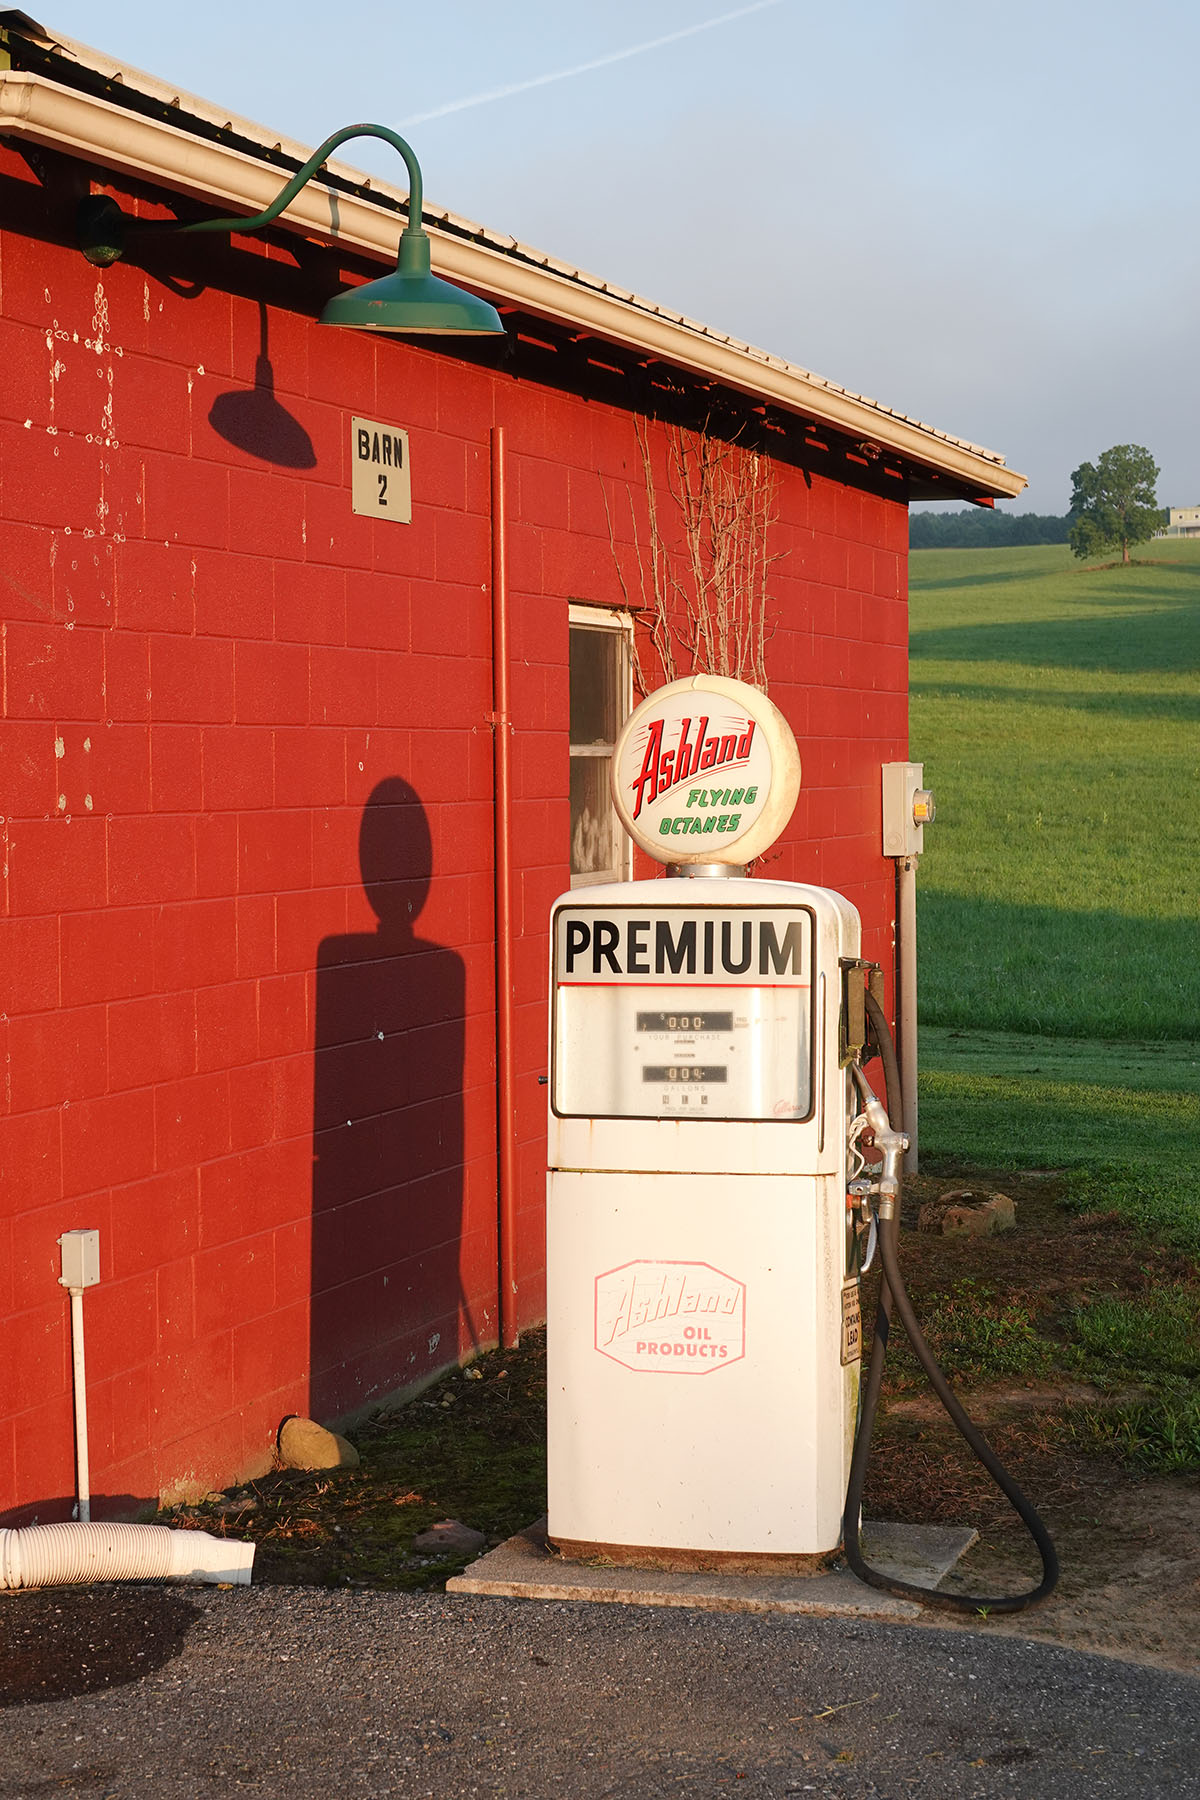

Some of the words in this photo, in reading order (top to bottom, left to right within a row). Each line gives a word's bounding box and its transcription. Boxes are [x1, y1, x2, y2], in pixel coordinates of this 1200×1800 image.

[358, 428, 402, 469] BARN
[378, 474, 388, 506] 2
[632, 716, 756, 821] Ashland
[686, 786, 758, 808] FLYING
[659, 814, 742, 835] OCTANES
[565, 920, 803, 976] PREMIUM
[603, 1274, 740, 1346] Ashland
[683, 1326, 711, 1340] OIL
[847, 1329, 858, 1346] LEAD
[636, 1342, 728, 1358] PRODUCTS
